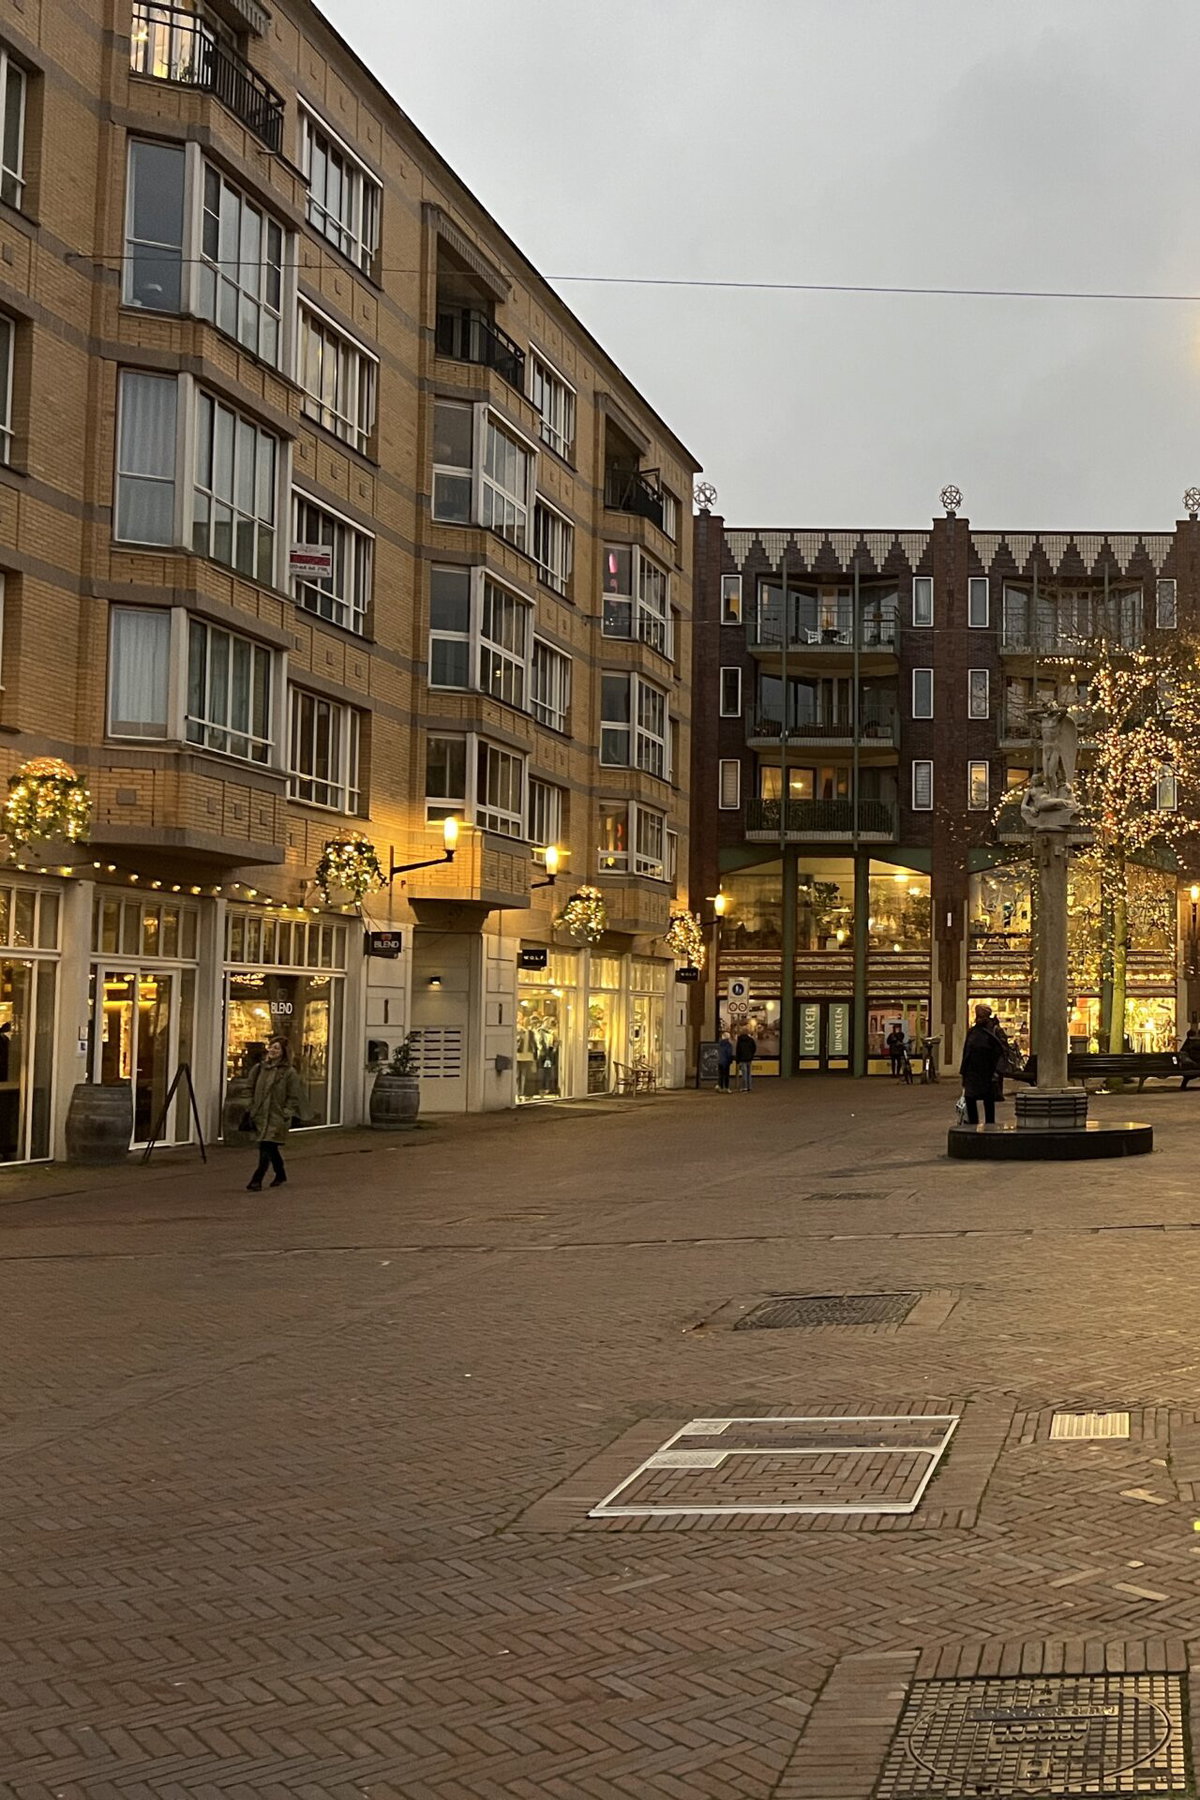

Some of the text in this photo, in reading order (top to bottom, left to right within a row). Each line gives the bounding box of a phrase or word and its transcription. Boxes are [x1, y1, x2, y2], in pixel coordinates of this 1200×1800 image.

[373, 941, 399, 949] BLEND
[271, 1002, 293, 1015] BLEND
[805, 1006, 816, 1051] LEKKER
[835, 1007, 843, 1051] WINKELEN
